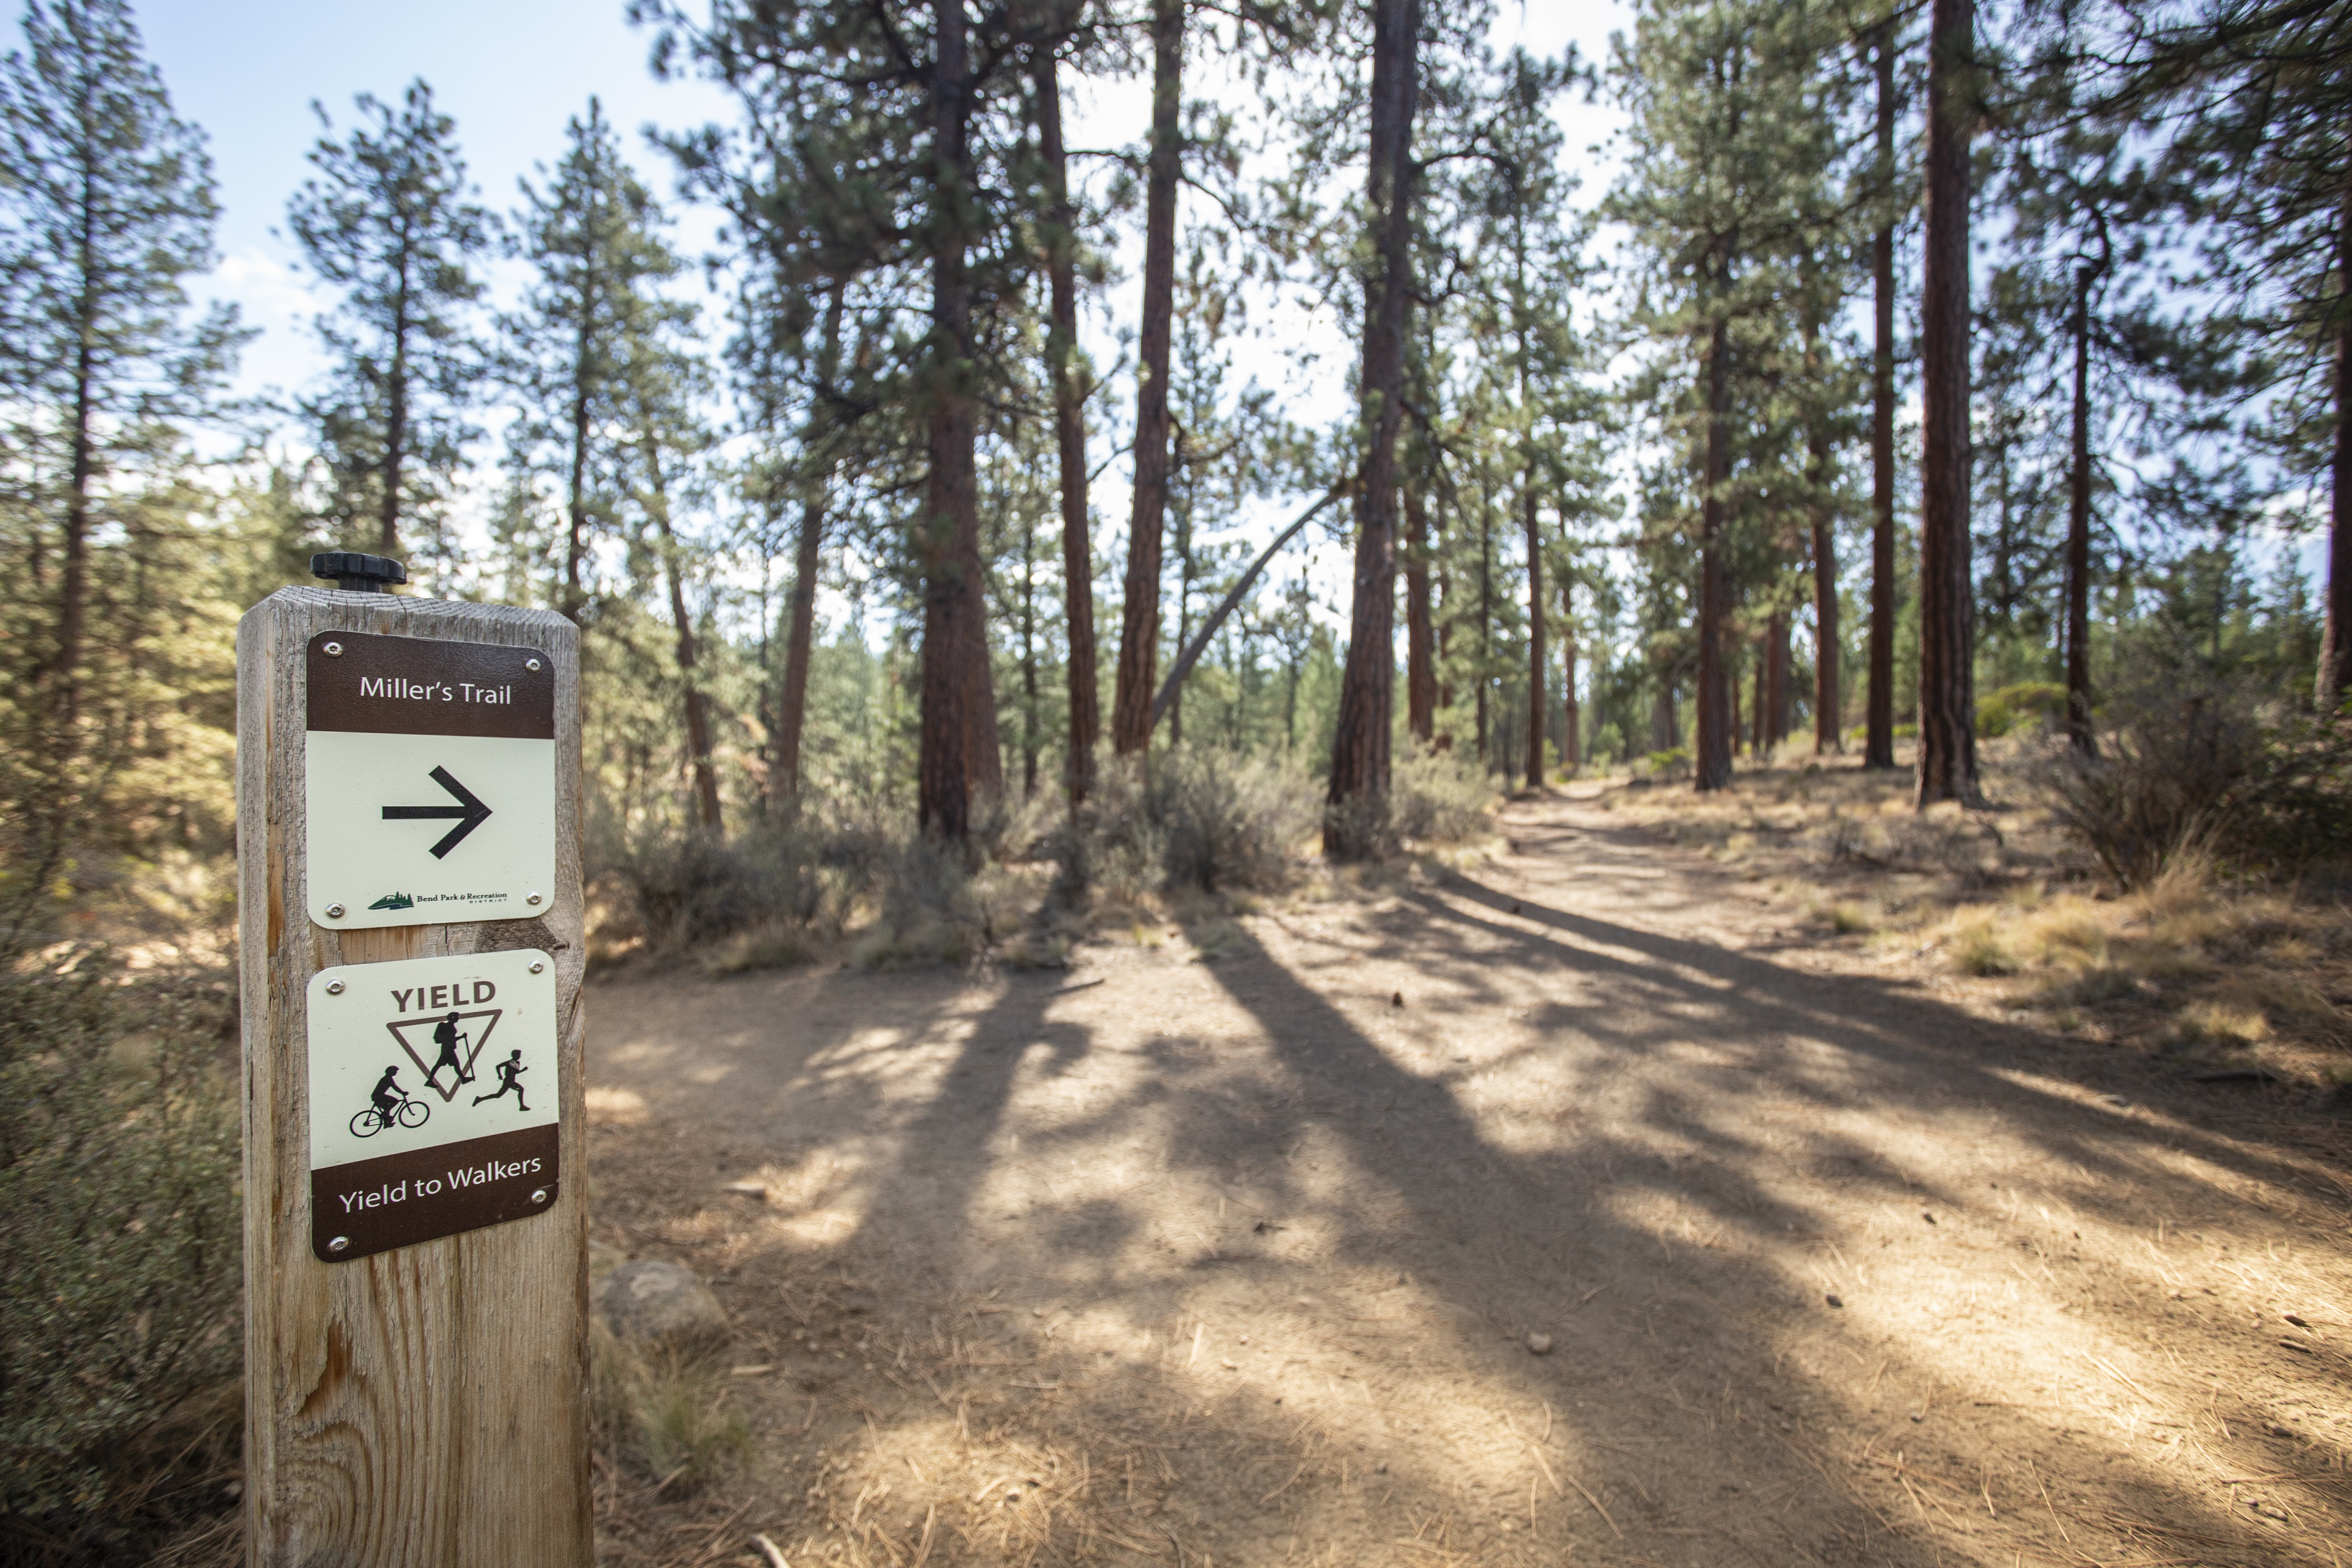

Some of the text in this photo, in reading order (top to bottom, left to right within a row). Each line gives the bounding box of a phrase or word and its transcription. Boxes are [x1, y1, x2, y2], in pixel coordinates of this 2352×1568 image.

[360, 677, 510, 704] Miller's Trail
[390, 980, 496, 1013] YIELD
[339, 1157, 541, 1213] Yield to Walkers
